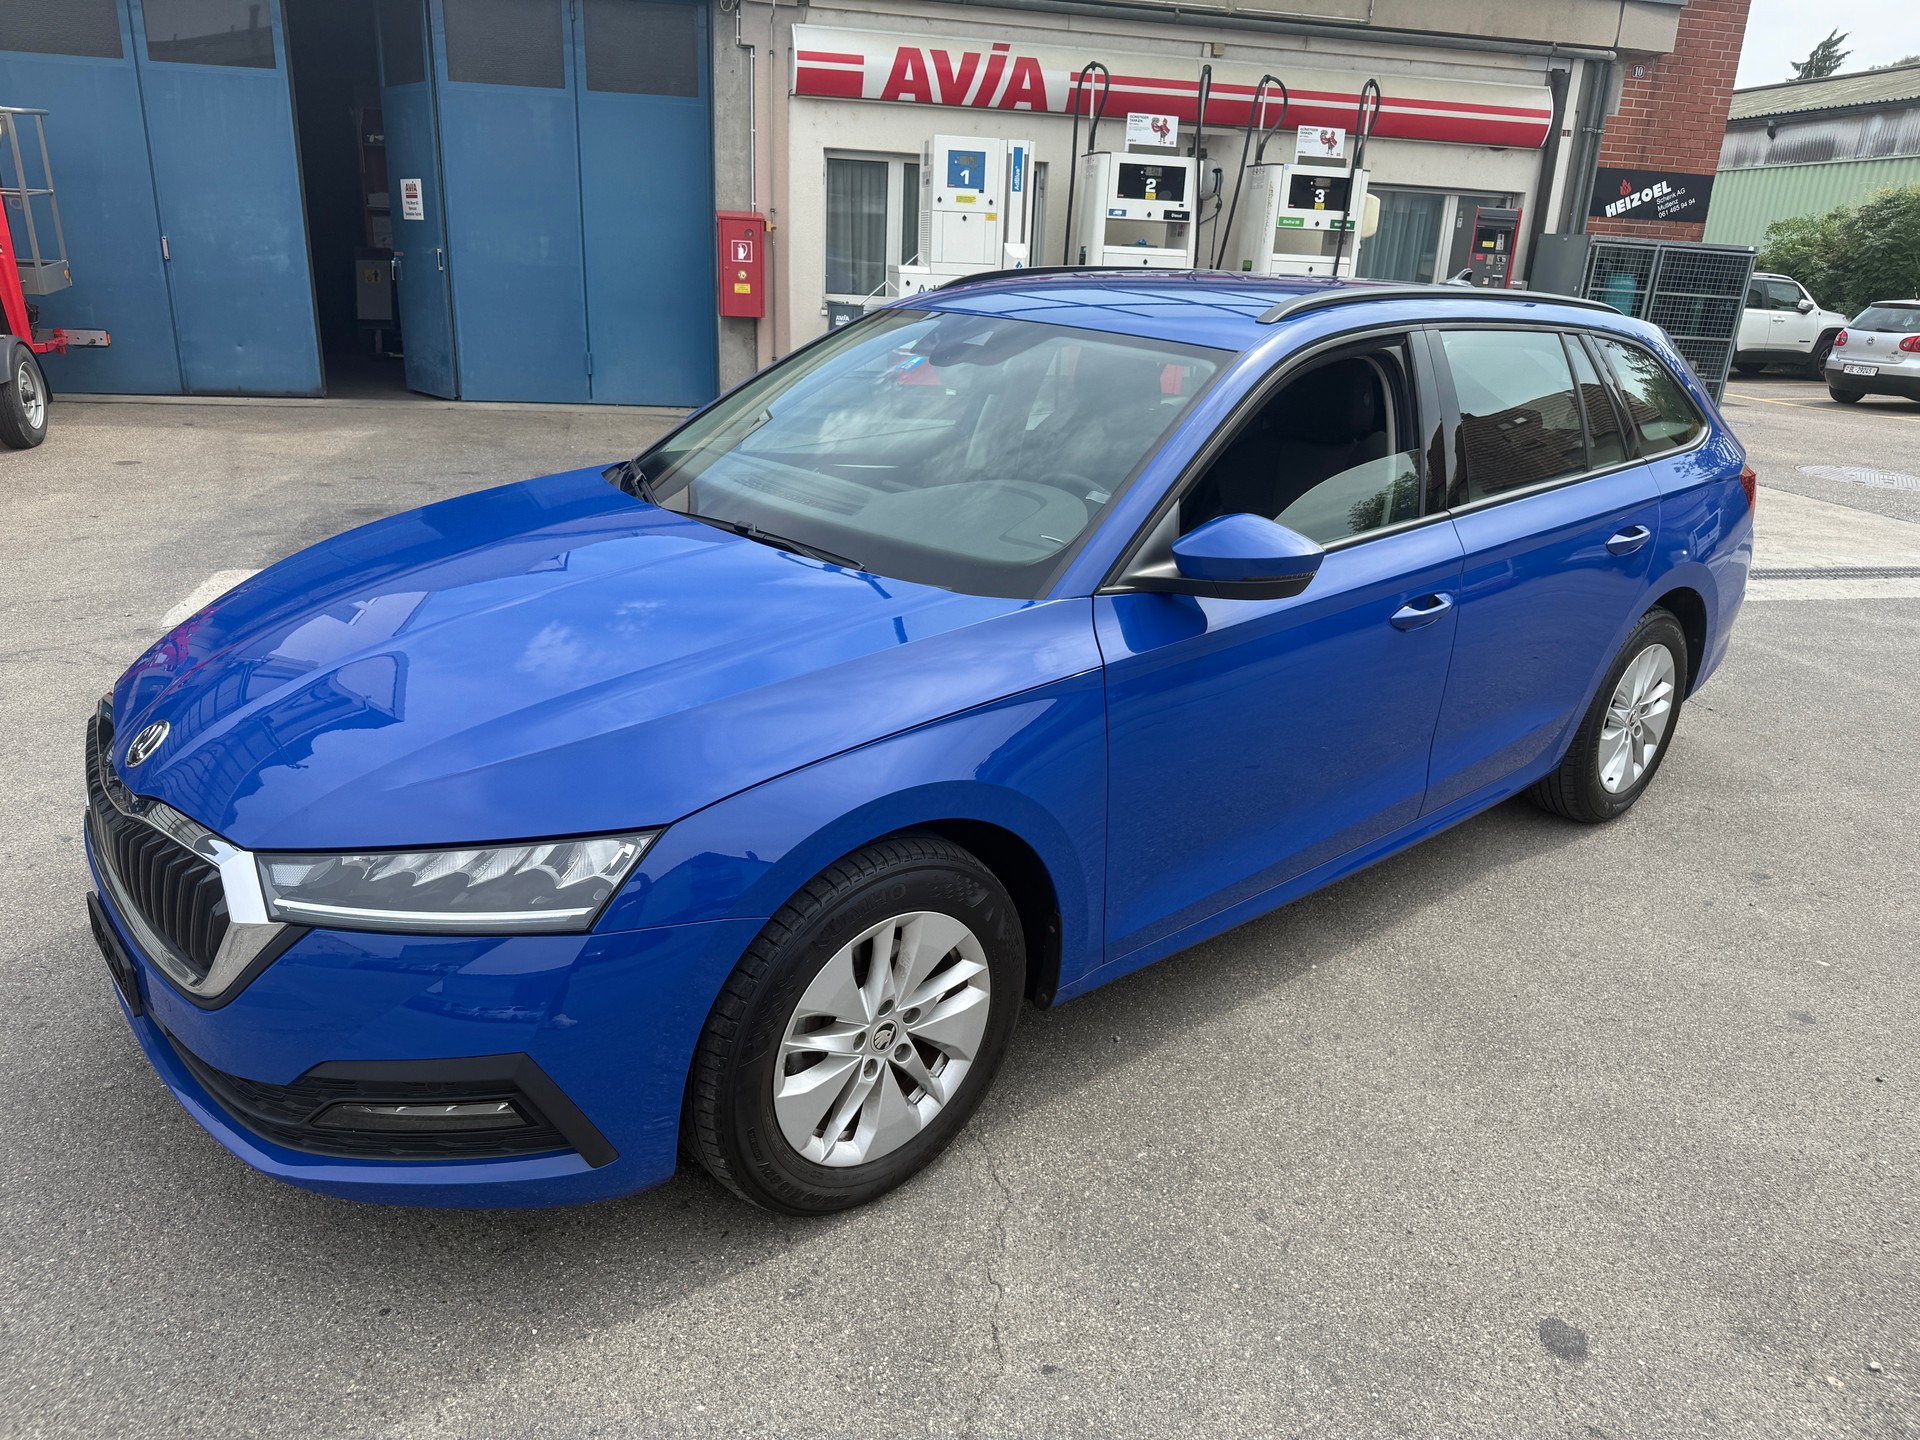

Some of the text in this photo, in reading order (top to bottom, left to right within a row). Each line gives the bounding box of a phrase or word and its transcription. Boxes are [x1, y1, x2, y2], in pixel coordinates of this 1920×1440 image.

[880, 43, 1048, 112] AVIA
[1635, 66, 1643, 77] 10
[960, 169, 970, 185] 1
[1145, 178, 1156, 192] 2
[1314, 189, 1325, 203] 3
[1605, 180, 1672, 218] HEIZOEL
[1656, 187, 1686, 205] Schenk AG
[1658, 210, 1669, 219] 061
[1680, 201, 1688, 210] 94
[1688, 197, 1696, 206] 94
